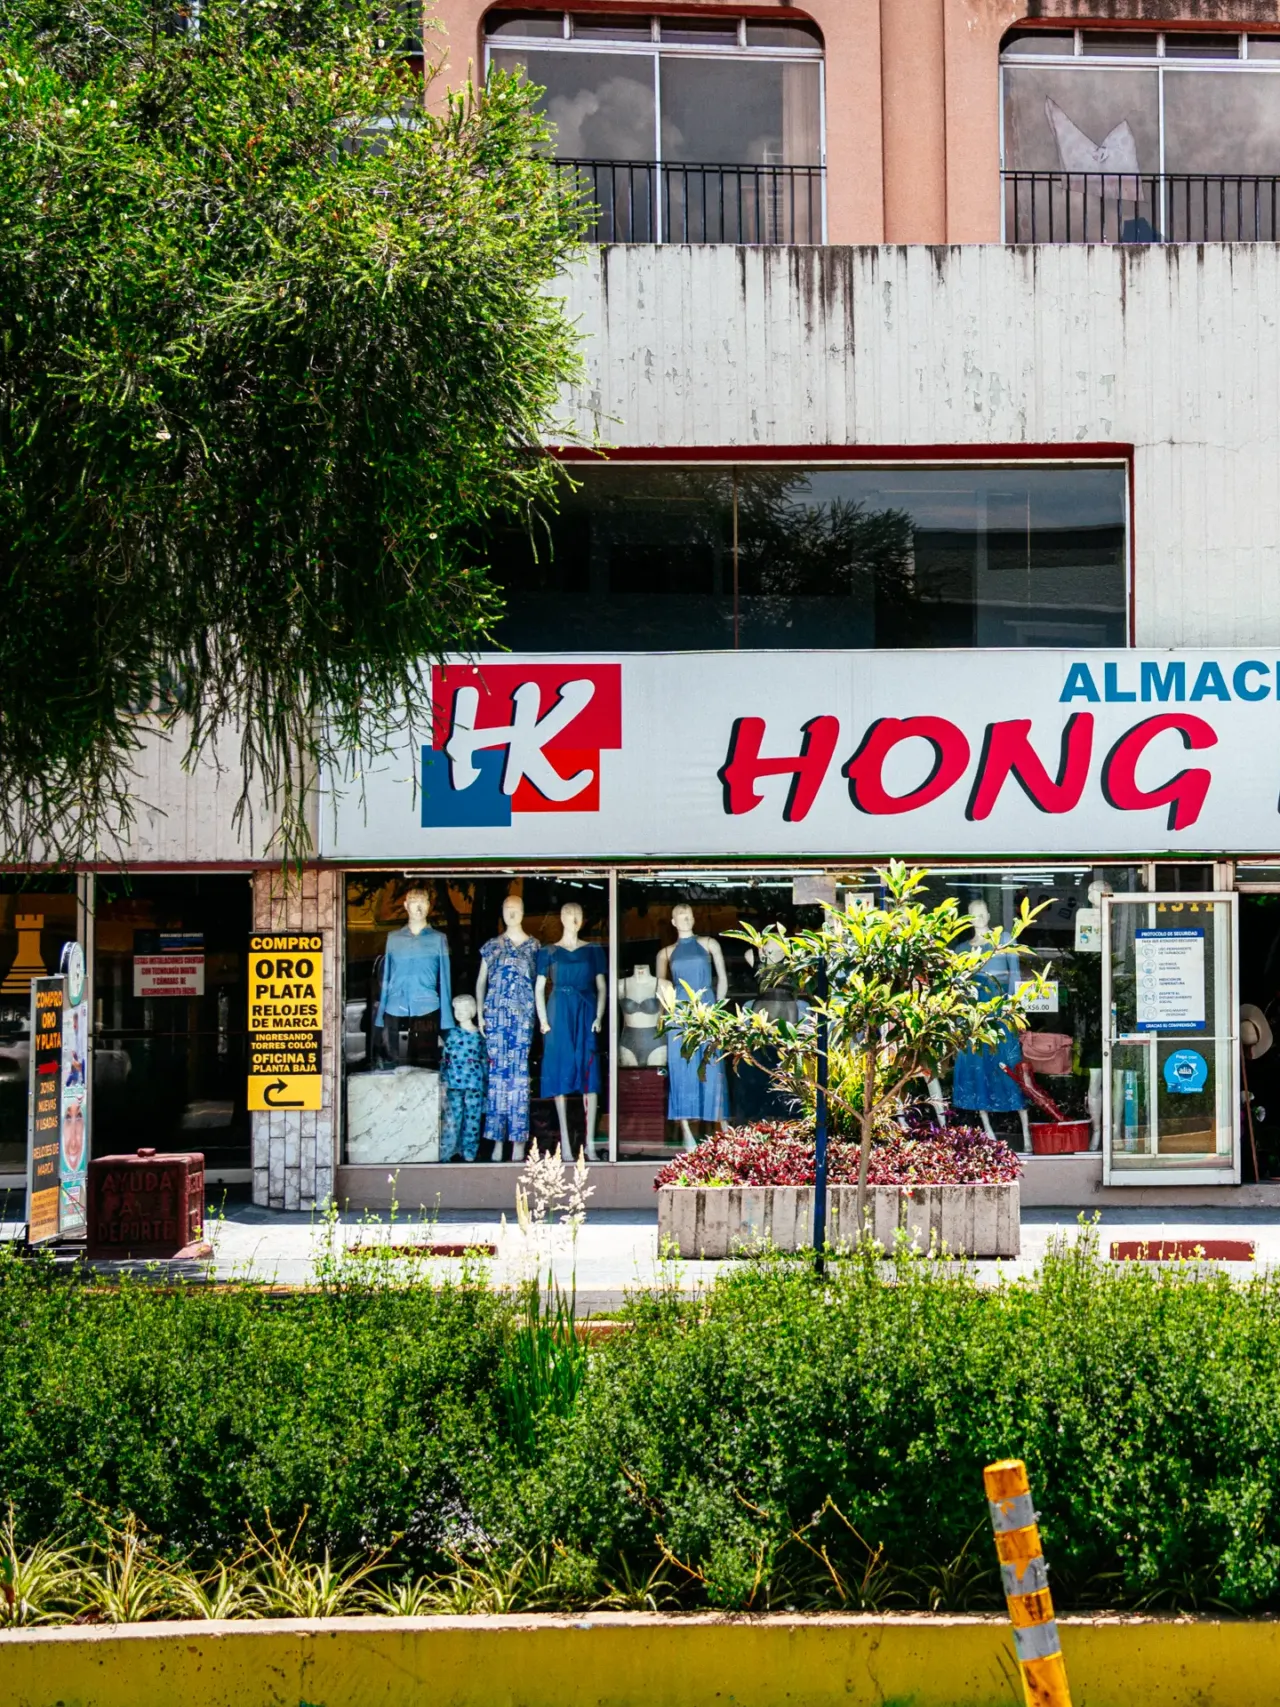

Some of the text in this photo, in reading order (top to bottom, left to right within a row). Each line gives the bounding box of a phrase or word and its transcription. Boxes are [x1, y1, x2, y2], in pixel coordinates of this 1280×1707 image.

[447, 678, 596, 802] HK
[717, 712, 1218, 830] HONG
[250, 936, 322, 950] COMPRO
[255, 958, 314, 979] ORO
[255, 983, 316, 999] PLATA
[35, 990, 63, 1009] COMPRO
[252, 1004, 318, 1016] RELOJES
[41, 1011, 57, 1029] ORO
[252, 1017, 318, 1028] DE MARCA
[35, 1032, 62, 1051] Y PLATA
[251, 1039, 318, 1050] TORRES COLÓN
[255, 1033, 313, 1041] INGRESANDO
[252, 1052, 317, 1064] OFICINA 5
[252, 1064, 317, 1073] PLANTA BAJA
[37, 1162, 54, 1176] MARCA
[100, 1171, 174, 1192] AYUDA
[98, 1219, 177, 1242] DEPORTE
